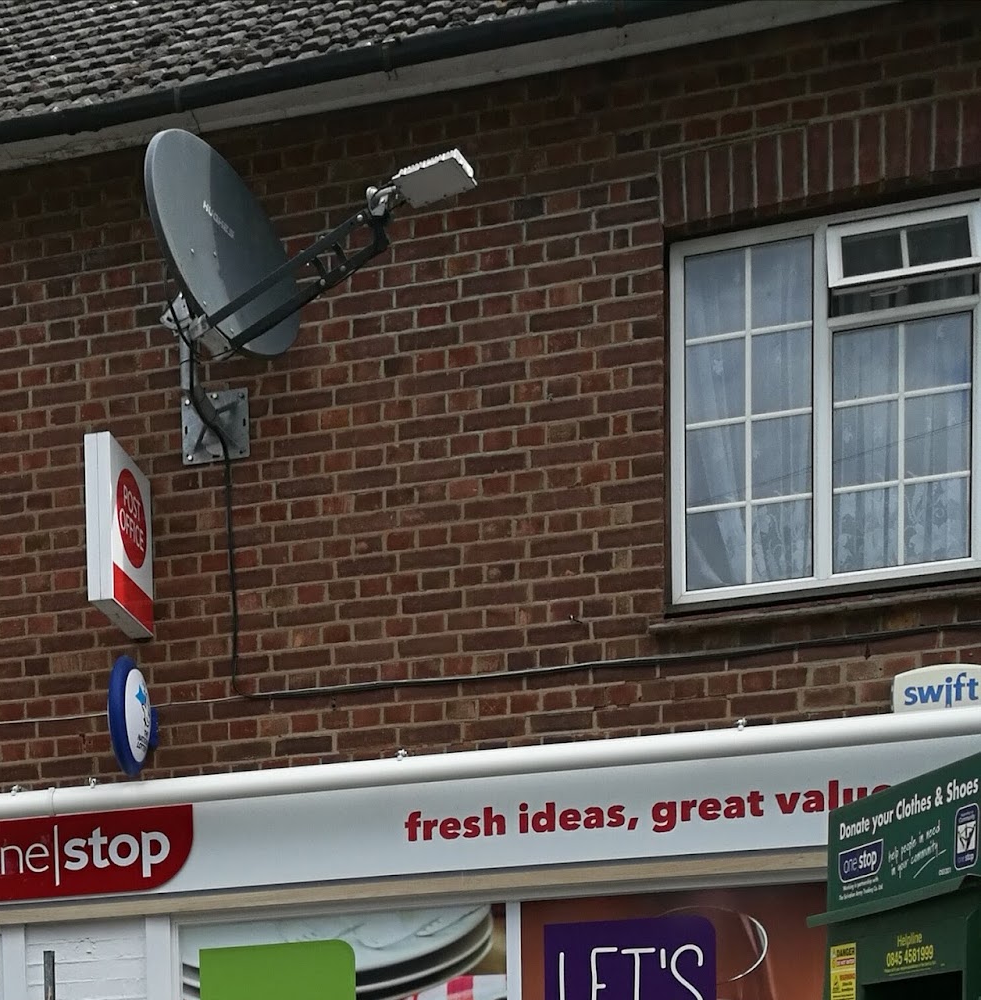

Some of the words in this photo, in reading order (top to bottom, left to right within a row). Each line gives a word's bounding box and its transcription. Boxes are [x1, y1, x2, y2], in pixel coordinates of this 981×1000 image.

[124, 484, 141, 521] POST
[119, 507, 144, 552] OFFICE
[904, 672, 979, 708] swift
[405, 806, 506, 842] fresh
[519, 802, 639, 834] ideas,
[651, 790, 764, 833] great
[839, 816, 870, 841] Donate
[871, 810, 894, 835] your
[895, 793, 932, 820] Clothes
[934, 786, 944, 807] &
[945, 778, 979, 803] Shoes
[64, 826, 170, 878] stop
[901, 836, 917, 861] people
[926, 819, 940, 840] need
[910, 840, 939, 865] community
[843, 856, 858, 874] one
[858, 849, 878, 872] stop
[886, 951, 903, 968] 0845
[903, 944, 934, 965] 4581999
[897, 932, 923, 948] Helpline
